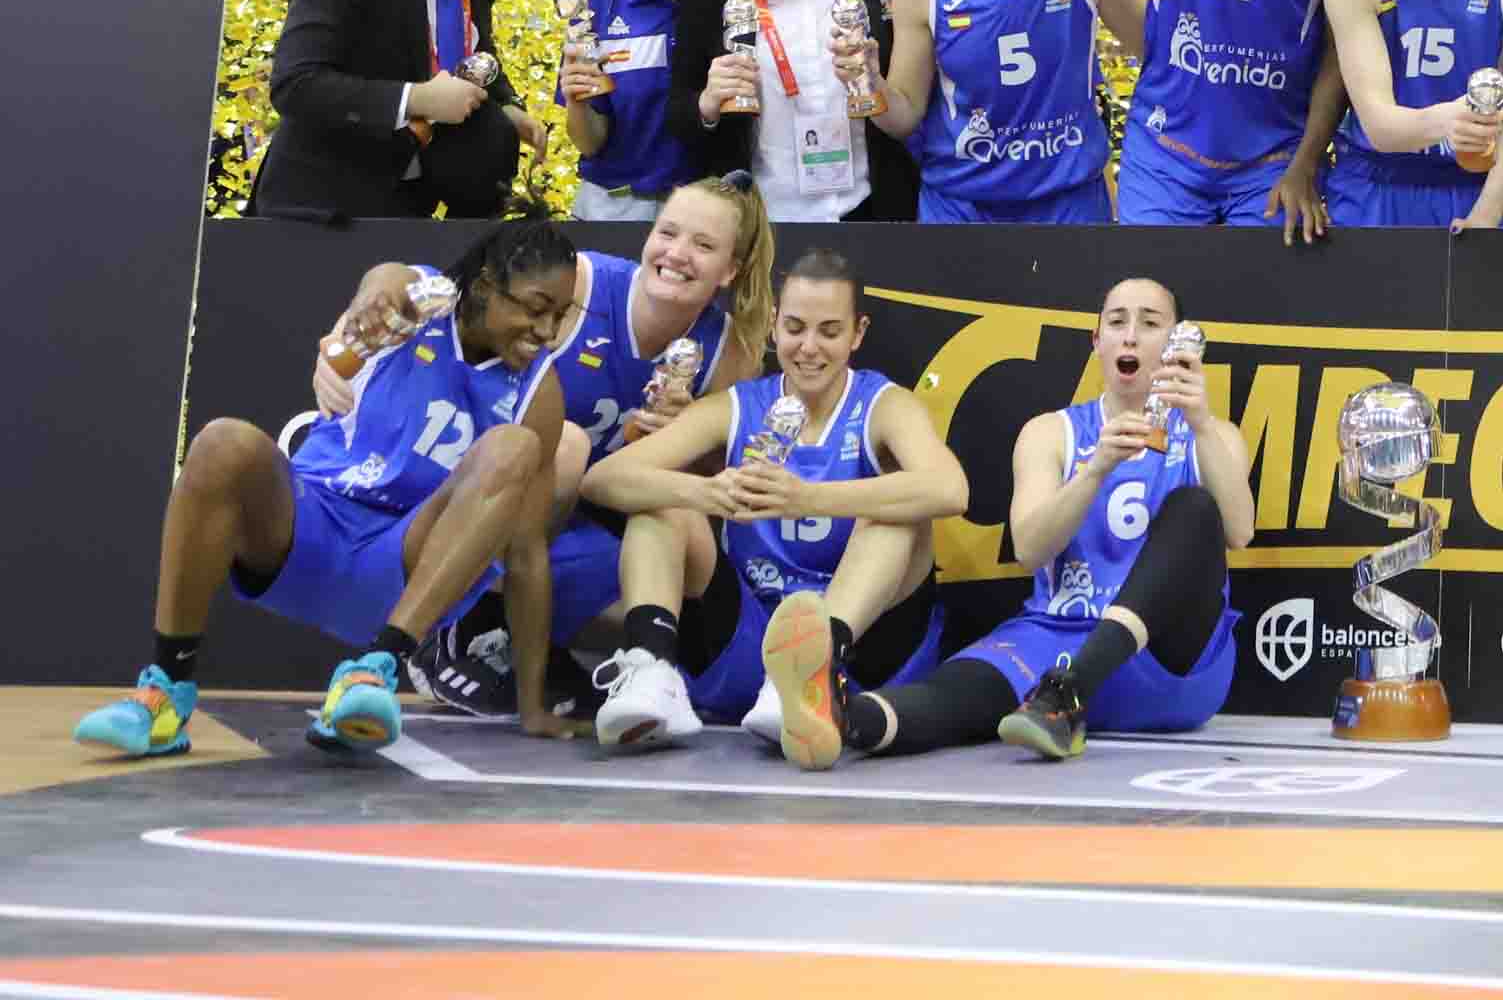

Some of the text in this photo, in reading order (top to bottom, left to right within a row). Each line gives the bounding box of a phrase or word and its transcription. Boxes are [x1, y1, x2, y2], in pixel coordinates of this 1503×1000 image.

[998, 32, 1037, 86] 5
[1400, 27, 1455, 78] 15
[413, 400, 475, 471] 12
[1106, 480, 1150, 541] 6
